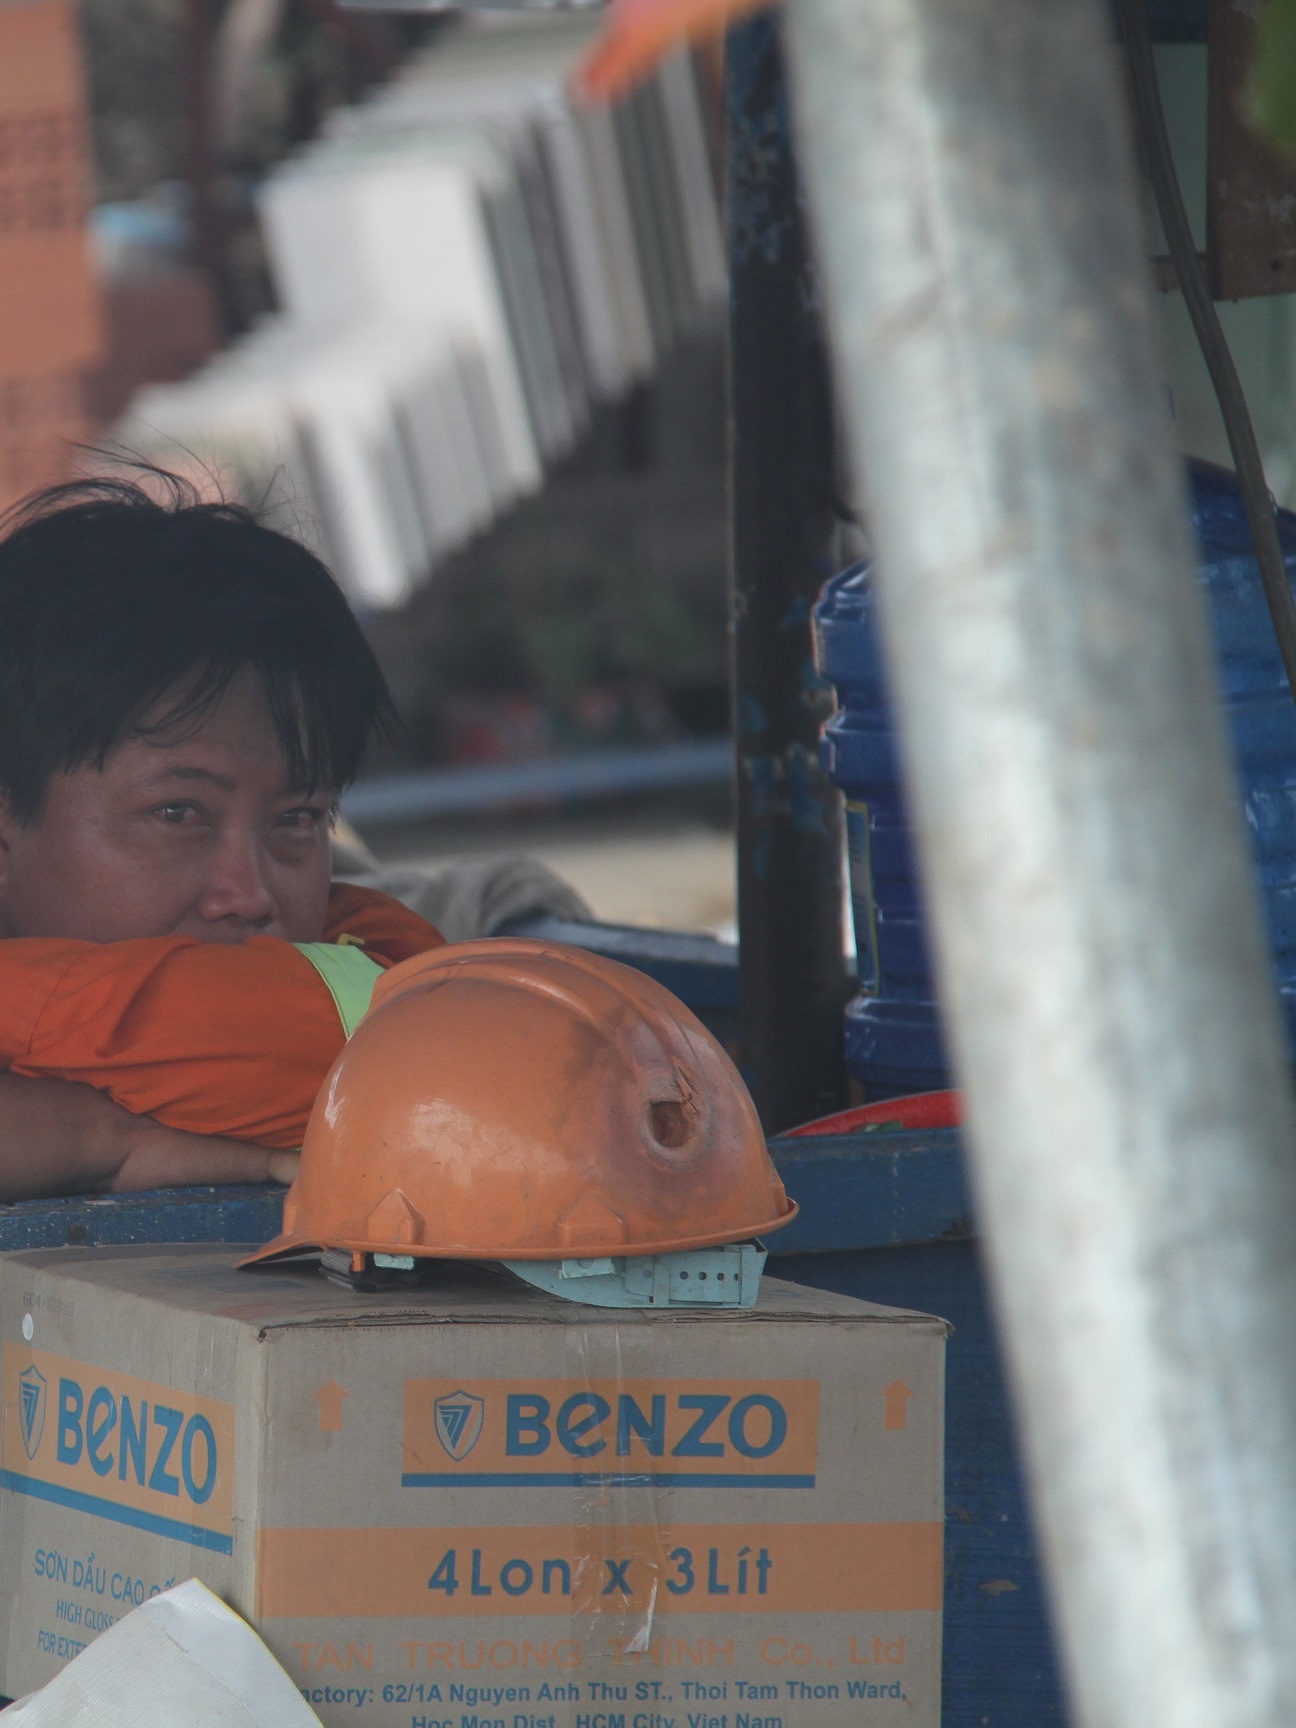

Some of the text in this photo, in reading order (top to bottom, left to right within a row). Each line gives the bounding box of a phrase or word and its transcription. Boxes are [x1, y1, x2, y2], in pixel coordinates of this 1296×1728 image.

[111, 1572, 144, 1606] CAO
[602, 1558, 633, 1596] x
[56, 1599, 82, 1625] HIGH
[37, 1630, 56, 1655] FOR
[292, 1641, 374, 1672] TAN
[399, 1637, 583, 1671] TRUONG
[849, 1635, 906, 1665] Ltd
[382, 1684, 442, 1703] 62/1A
[449, 1683, 531, 1707] Nguyen
[537, 1683, 580, 1702] Anh
[588, 1682, 627, 1701] Thu
[681, 1681, 727, 1700] Thoi
[735, 1681, 778, 1700] Tam
[786, 1681, 839, 1699] Thon
[847, 1681, 906, 1701] Ward,
[576, 1714, 624, 1728] HCM
[736, 1712, 782, 1728] Nam
